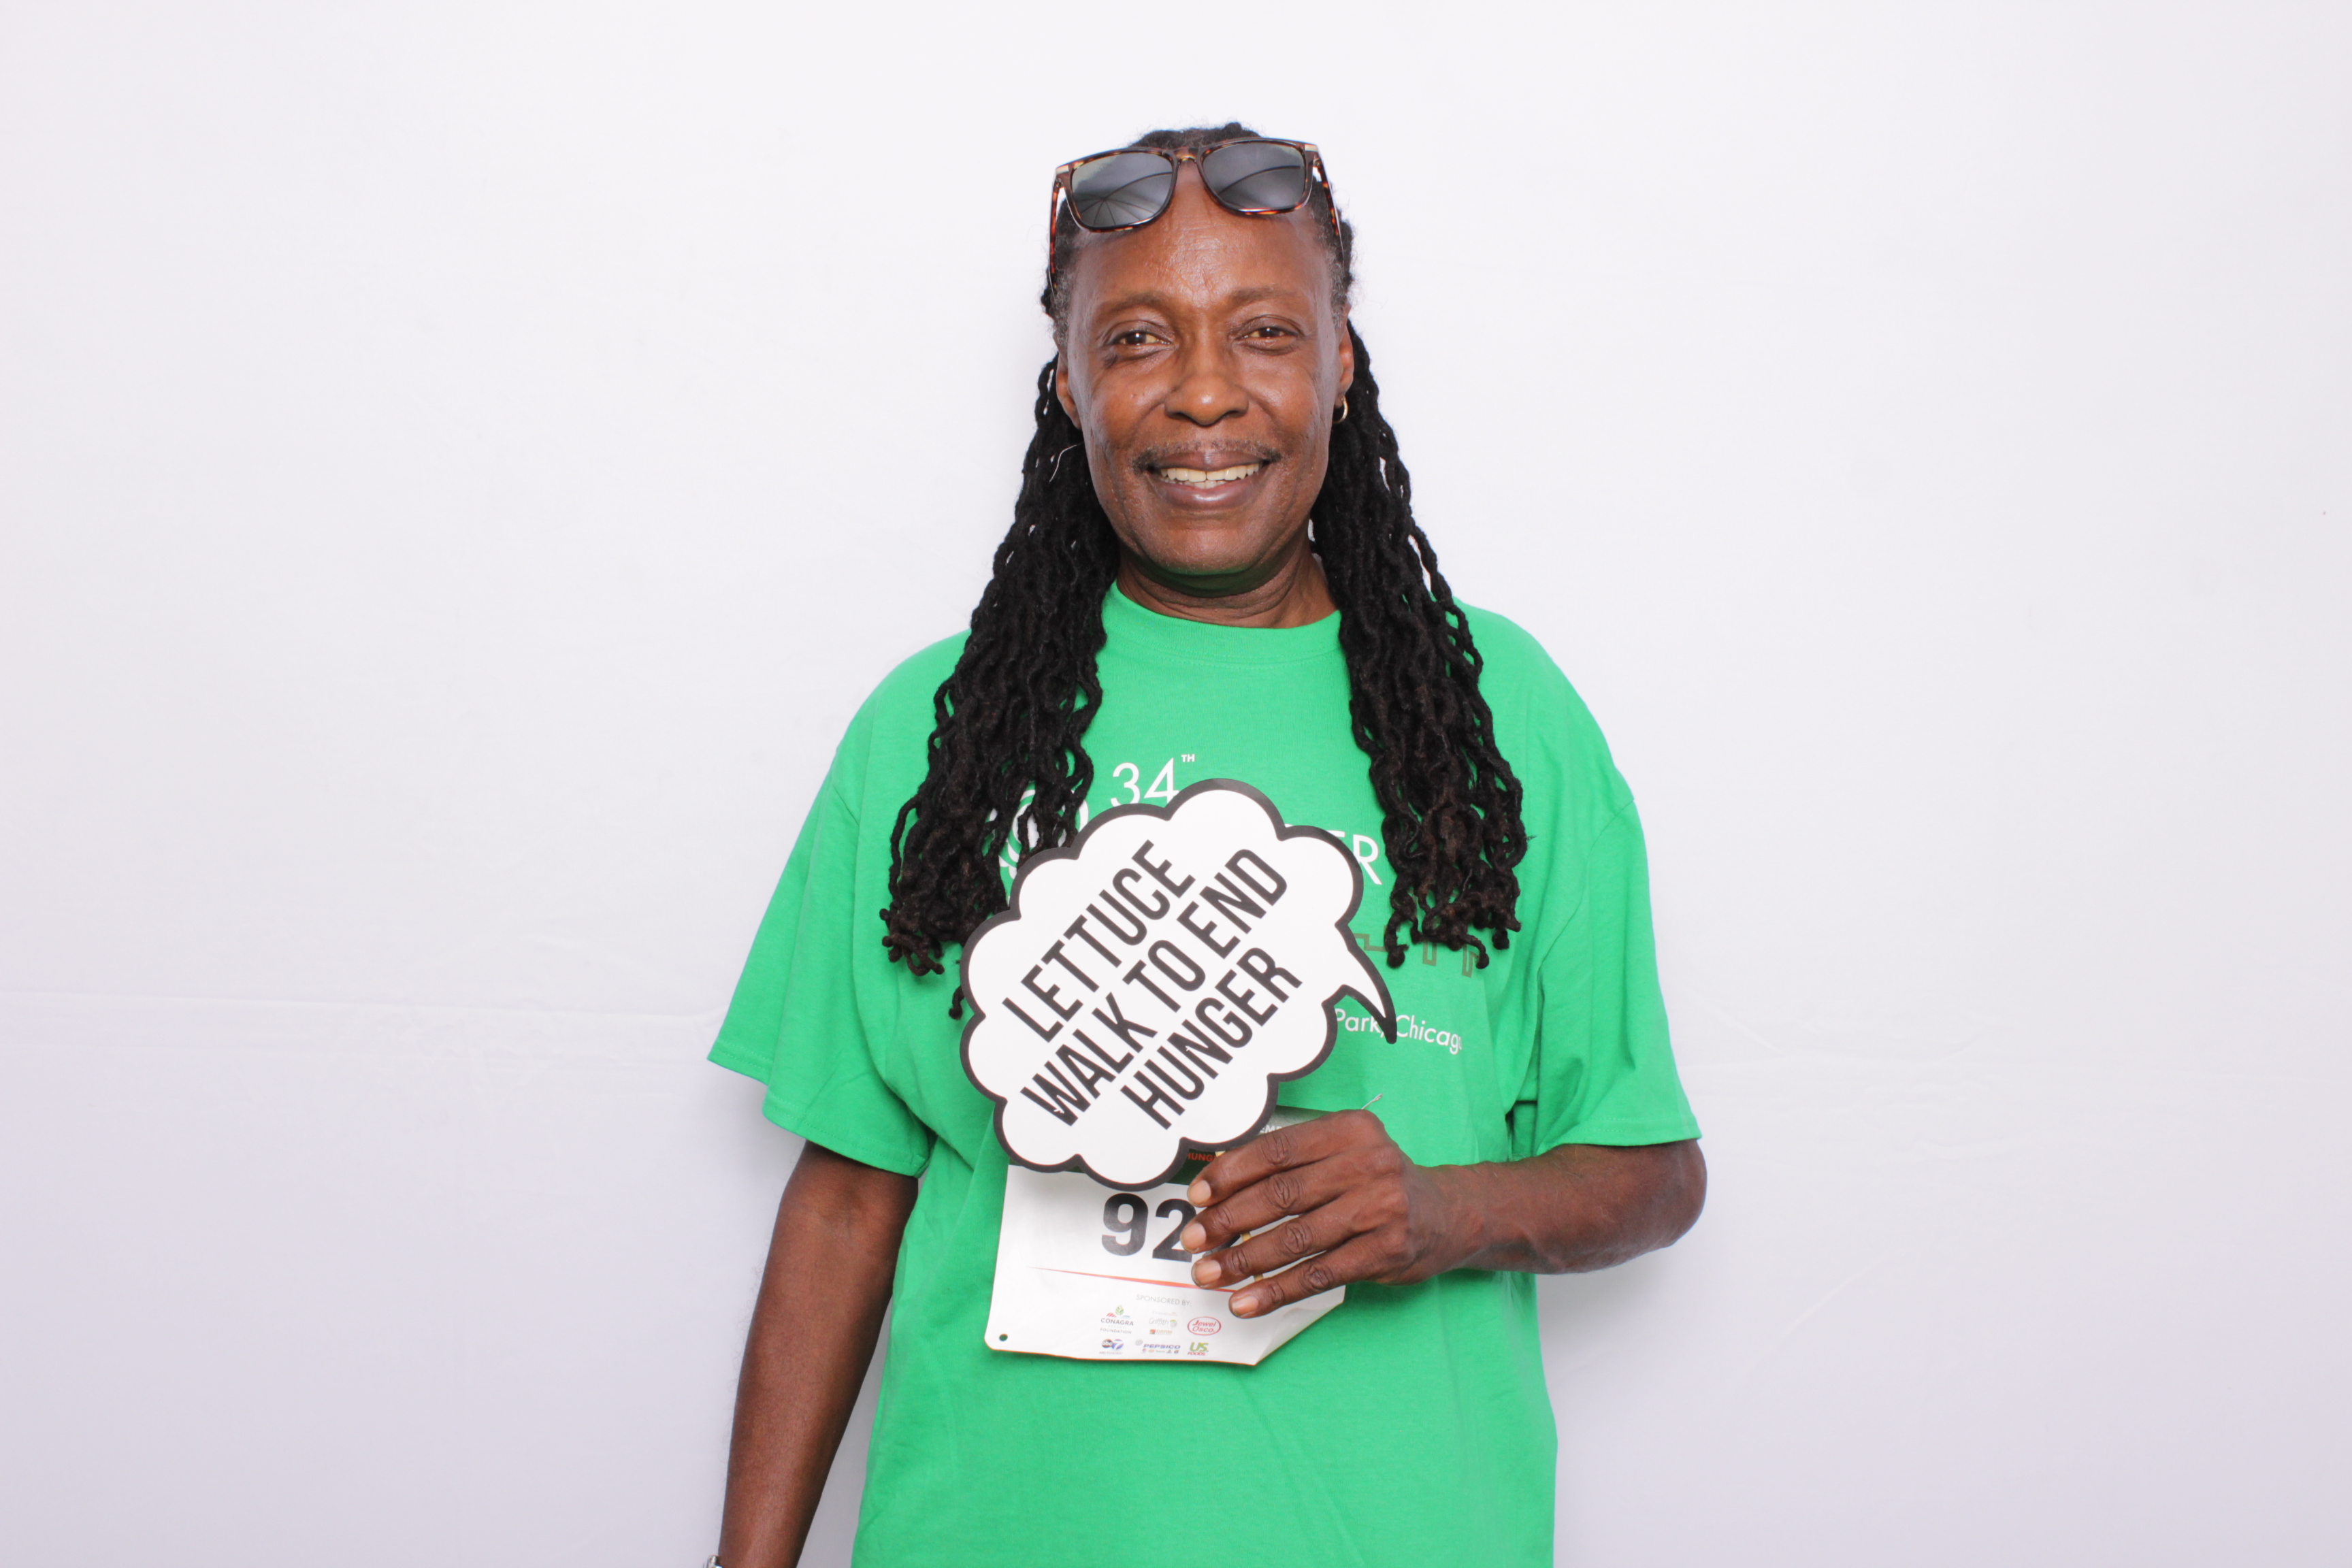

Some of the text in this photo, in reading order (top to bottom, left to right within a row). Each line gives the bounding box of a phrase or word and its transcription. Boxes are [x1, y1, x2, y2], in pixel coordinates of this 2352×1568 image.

[1002, 839, 1196, 1043] LETTUCE
[1020, 849, 1288, 1127] WALK TO END
[1120, 947, 1303, 1130] HUNGER
[1101, 1192, 1241, 1262] 92
[1100, 1318, 1134, 1326] CONAGRA
[1136, 1294, 1180, 1305] SPONSORED
[1148, 1317, 1169, 1326] Griffith
